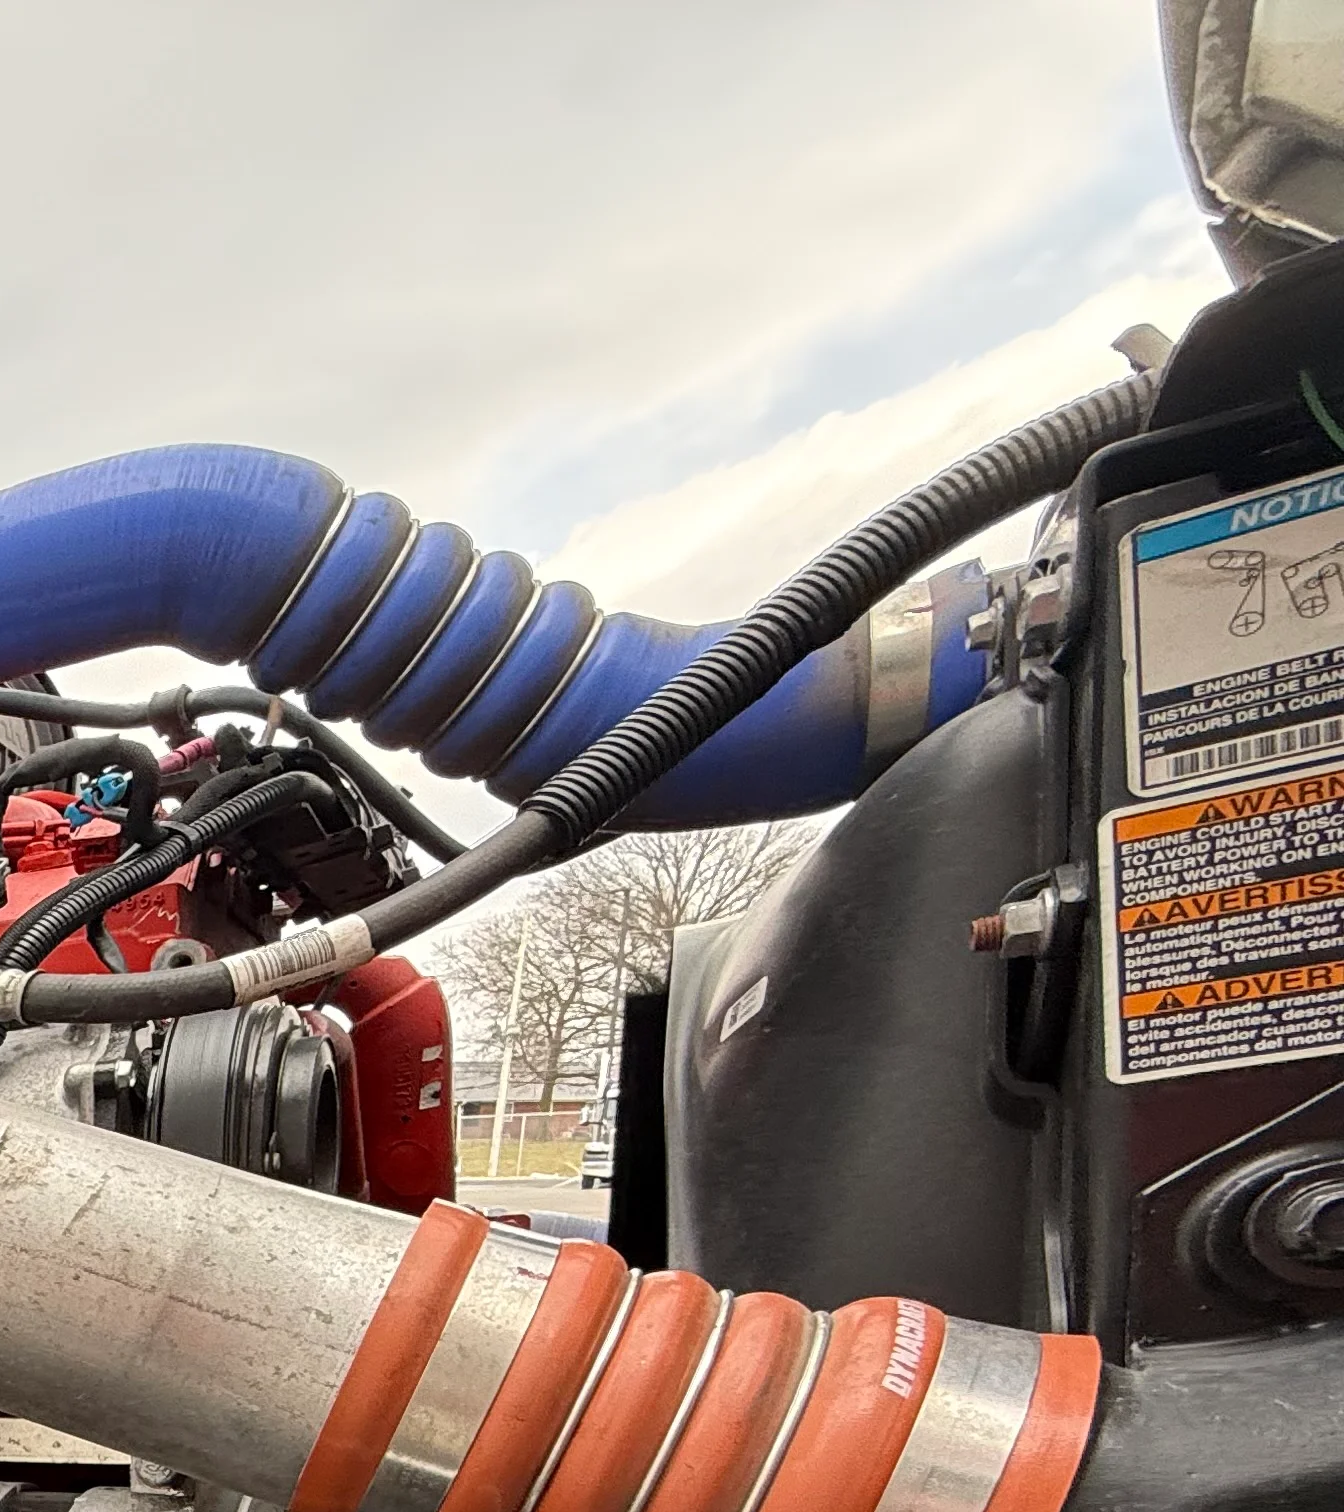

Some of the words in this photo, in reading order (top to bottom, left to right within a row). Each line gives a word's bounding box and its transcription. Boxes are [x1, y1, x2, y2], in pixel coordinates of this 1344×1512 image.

[1193, 667, 1270, 697] ENGINE
[1277, 654, 1327, 678] BELT
[1148, 686, 1269, 726] INSTALACION
[1274, 678, 1301, 698] DE
[1143, 713, 1233, 745] PARCOURS
[1236, 707, 1260, 725] DE
[1264, 701, 1286, 719] LA
[1121, 831, 1191, 857] ENGINE
[1197, 815, 1264, 841] COULD
[1269, 800, 1335, 826] START
[1122, 853, 1147, 870] TO
[1152, 840, 1211, 864] AVOID
[1122, 853, 1209, 882] BATTERY
[1214, 837, 1287, 864] POWER
[1291, 831, 1319, 848] TO
[1123, 873, 1178, 895] WHEN
[1183, 853, 1277, 883] WORKING
[1281, 846, 1312, 863] ON
[1122, 869, 1262, 908] COMPONENTS.
[1124, 931, 1145, 946] Le
[1150, 918, 1214, 941] moteur
[1218, 909, 1263, 928] peux
[1291, 910, 1335, 929] Pour
[1125, 960, 1192, 983] lorsque
[1196, 953, 1231, 970] des
[1234, 940, 1303, 964] travaux
[1126, 981, 1142, 994] le
[1146, 968, 1214, 991] moteur.
[1127, 1018, 1145, 1032] El
[1150, 1009, 1203, 1029] motor
[1207, 999, 1264, 1020] puede
[1128, 1028, 1170, 1045] evite
[1128, 1044, 1155, 1058] del
[1159, 1027, 1258, 1054] arrancador
[1262, 1015, 1333, 1038] cuando
[1129, 1042, 1250, 1072] componentes
[1254, 1037, 1283, 1052] del
